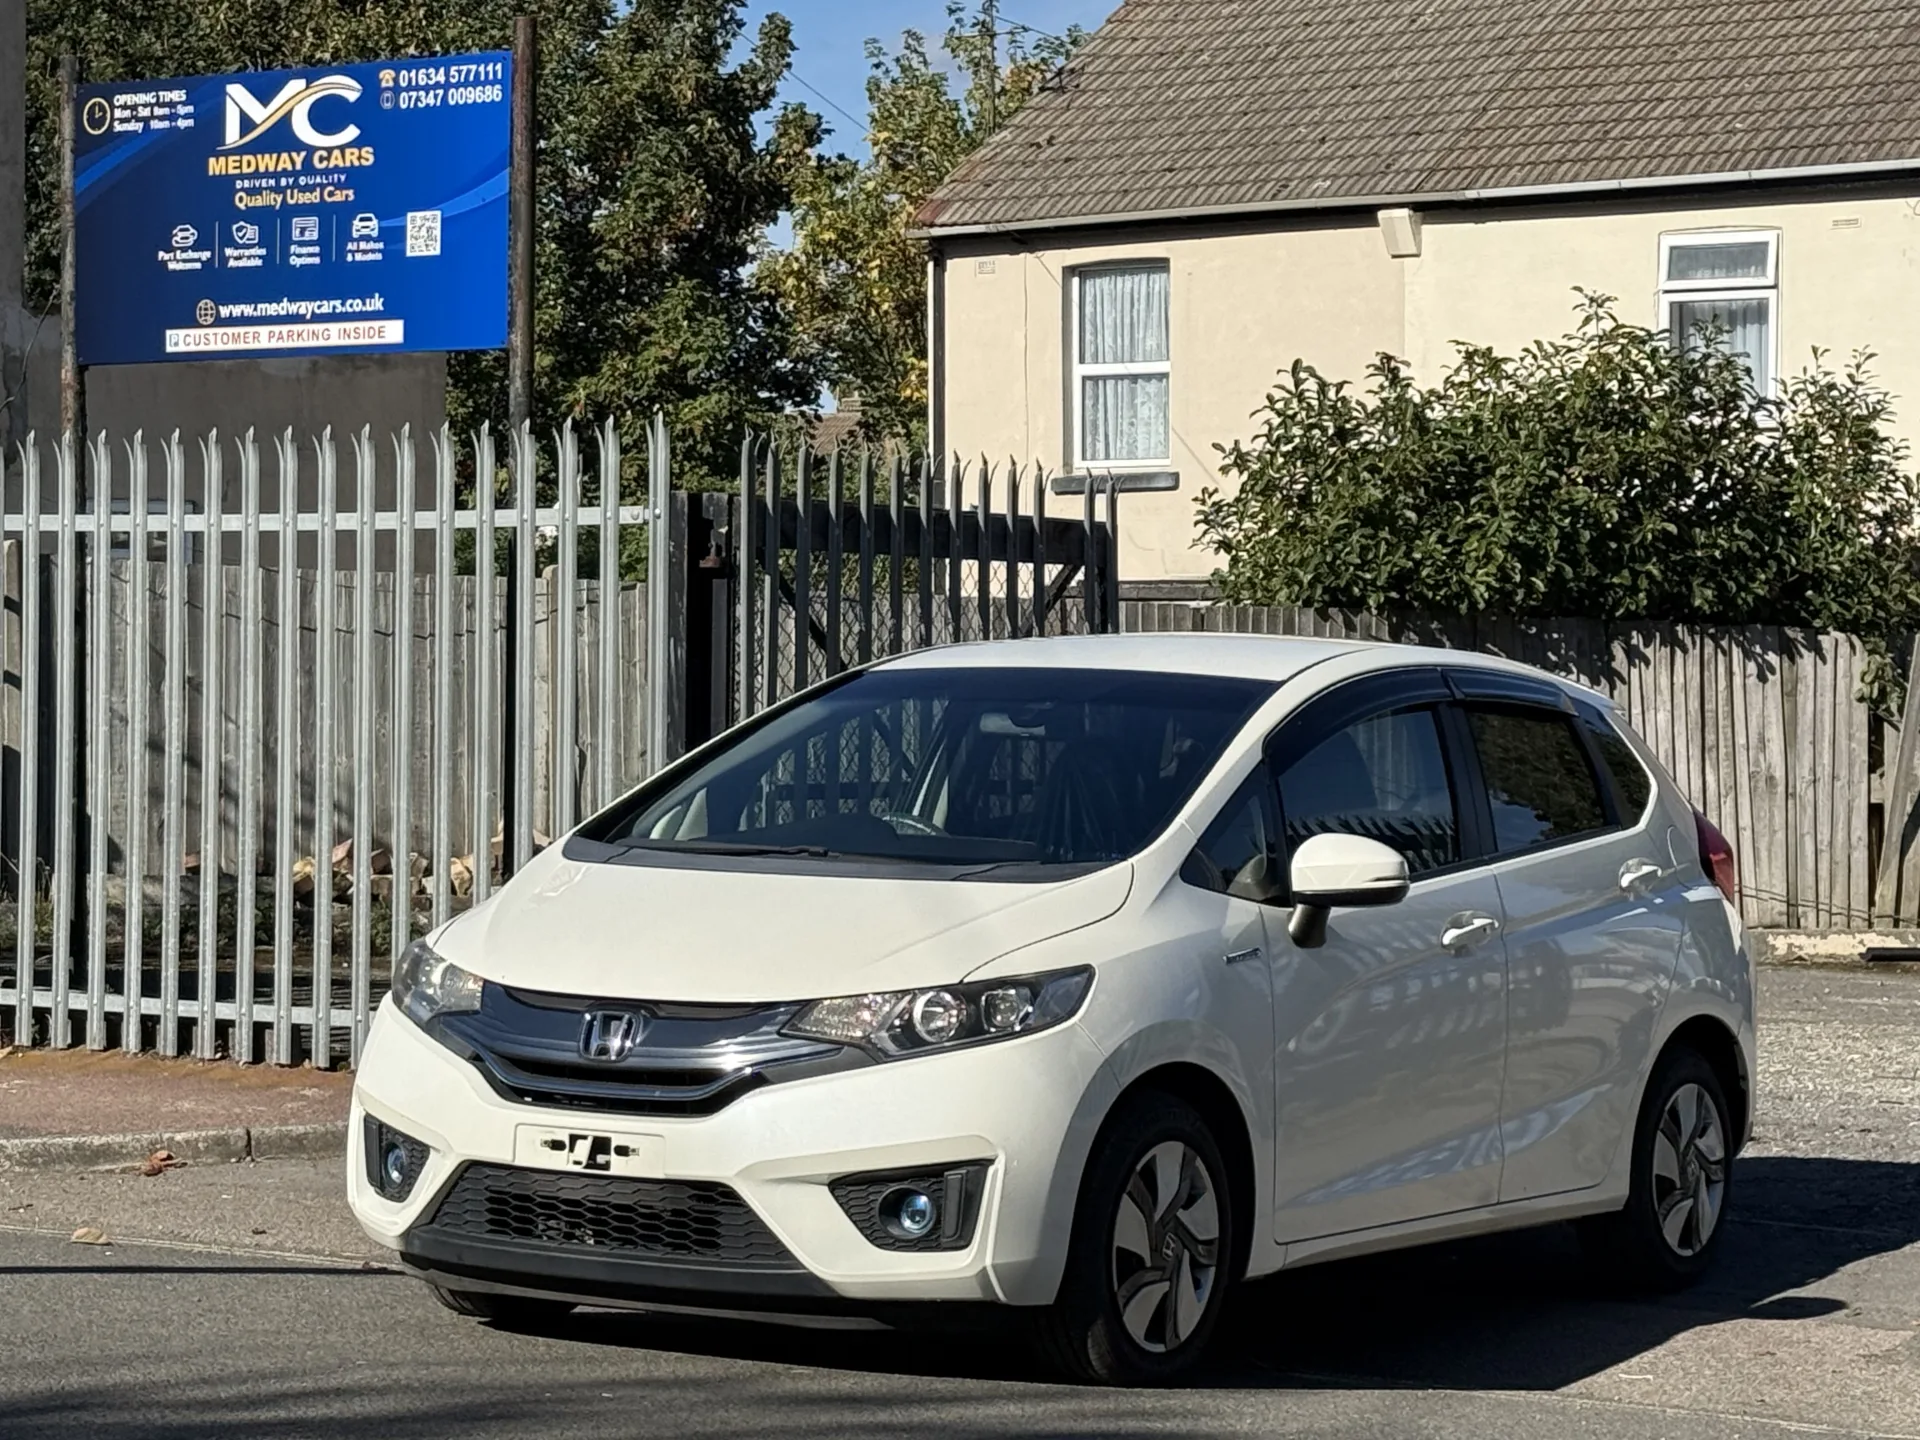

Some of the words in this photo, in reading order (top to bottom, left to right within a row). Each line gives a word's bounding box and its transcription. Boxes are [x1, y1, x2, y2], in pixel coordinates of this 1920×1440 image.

[399, 66, 446, 88] 01634
[449, 62, 503, 83] 577111
[113, 92, 157, 106] OPENING
[158, 89, 187, 103] TIMES
[399, 89, 445, 109] 07347
[448, 84, 503, 106] 009686
[113, 119, 144, 133] Sunday
[208, 151, 307, 176] MEDWAY
[312, 147, 375, 169] CARS
[235, 178, 276, 189] DRIVEN
[280, 177, 295, 187] BY
[298, 173, 347, 186] QUALITY
[234, 190, 283, 210] Quality
[286, 188, 320, 205] Used
[323, 186, 355, 202] Cars
[158, 251, 174, 261] Part
[175, 249, 212, 261] Exchange
[290, 245, 320, 254] Finance
[289, 255, 321, 268] Options
[219, 293, 384, 319] www.medwaycars.co.uk
[183, 331, 262, 346] CUSTOMER
[267, 327, 332, 342] PARKING
[338, 325, 387, 340] INSIDE
